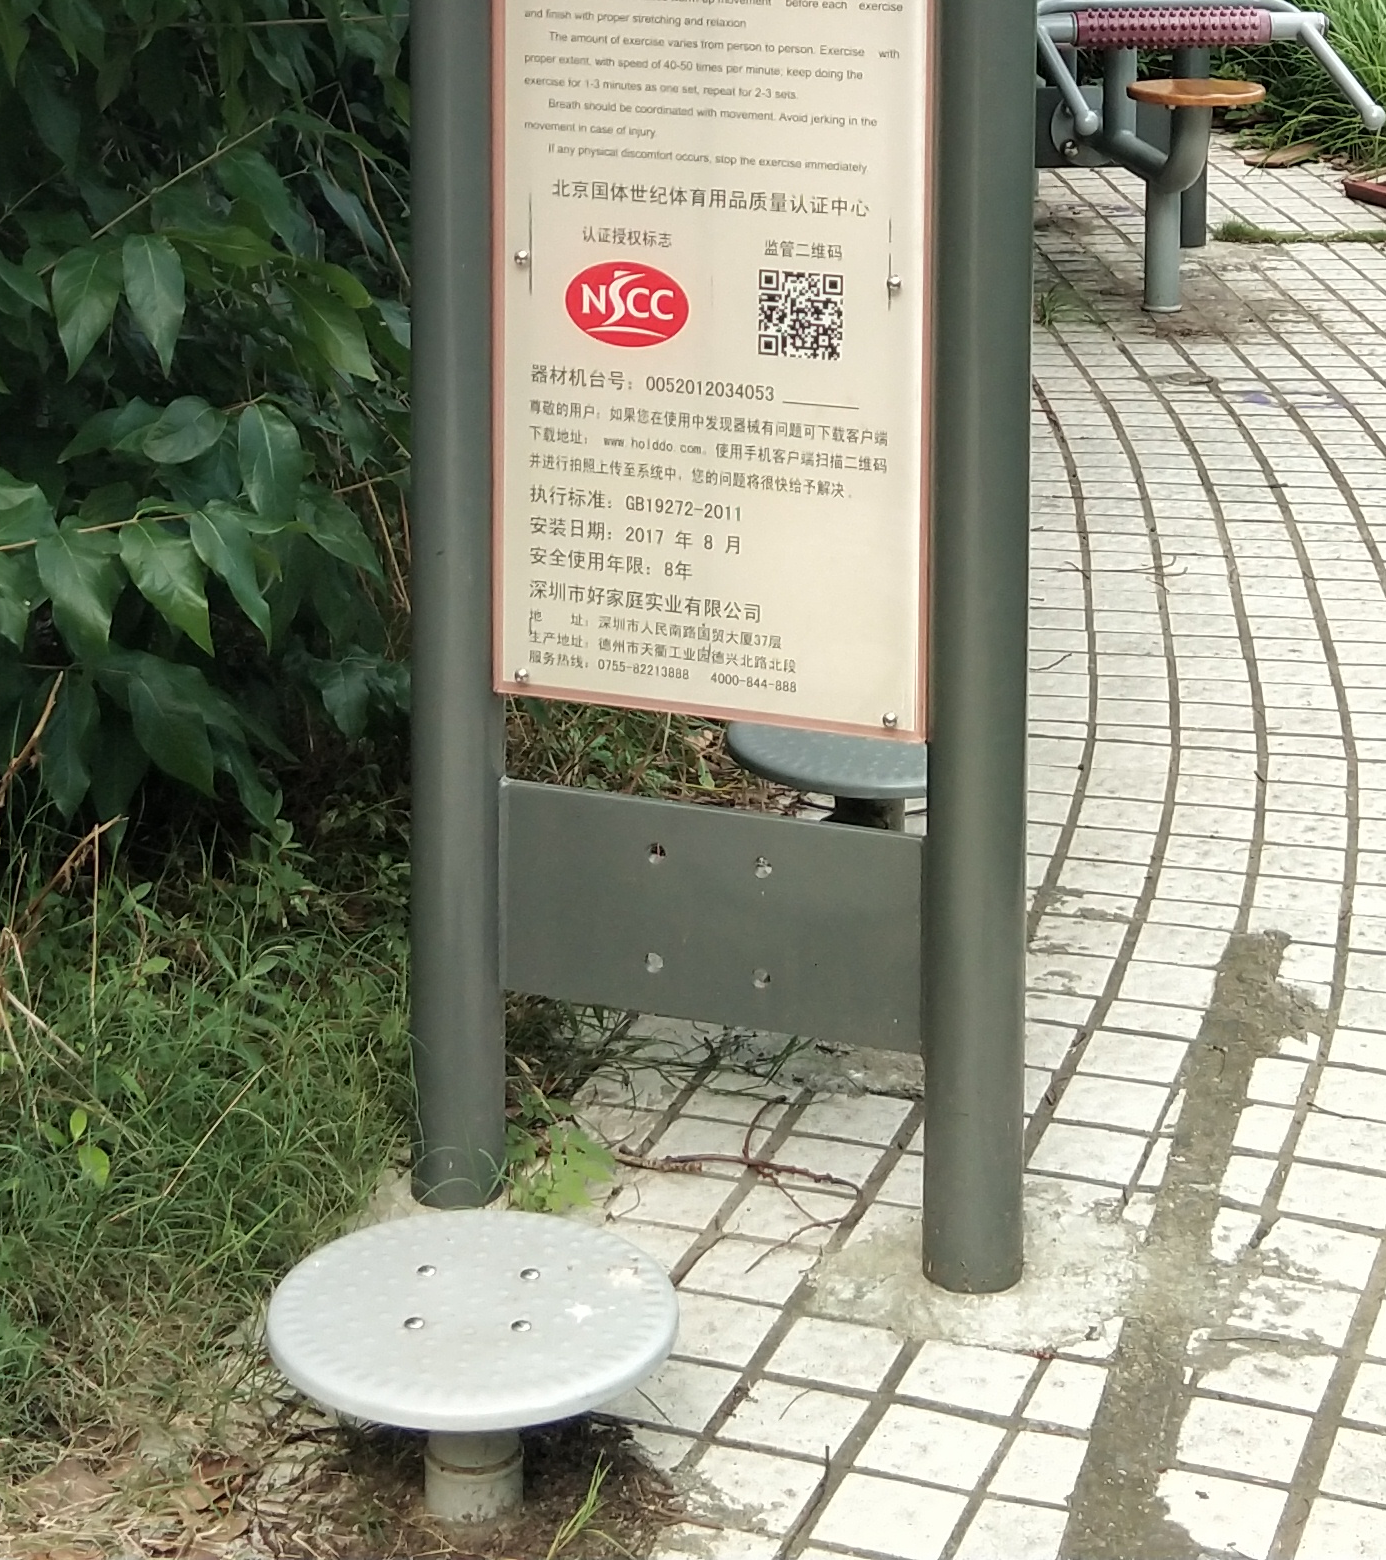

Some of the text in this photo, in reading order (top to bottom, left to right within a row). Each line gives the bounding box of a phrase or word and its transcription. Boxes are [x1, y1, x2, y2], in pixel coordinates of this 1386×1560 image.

[822, 0, 847, 9] each
[859, 2, 903, 11] exercise
[524, 10, 542, 18] and
[546, 9, 571, 19] finish
[575, 11, 594, 20] with
[597, 14, 628, 23] proper
[633, 15, 681, 27] stretching
[684, 16, 703, 26] and
[550, 31, 567, 42] The
[571, 34, 607, 44] amount
[611, 36, 620, 44] of
[623, 37, 664, 46] exercise
[668, 40, 698, 48] varies
[701, 41, 723, 50] from
[727, 42, 762, 51] person
[765, 43, 774, 52] to
[820, 45, 865, 57] Exercise
[879, 50, 899, 59] with
[524, 54, 556, 64] proper
[595, 58, 615, 67] with
[618, 59, 648, 69] speed
[651, 60, 660, 69] of
[663, 60, 693, 70] 40-50
[696, 63, 723, 72] times
[726, 65, 743, 74] per
[787, 68, 812, 78] keep
[815, 69, 843, 81] doing
[847, 70, 863, 80] the
[524, 77, 565, 86] exercise
[568, 79, 581, 87] for
[585, 79, 600, 88] 1-3
[603, 81, 642, 92] minutes
[645, 83, 657, 91] as
[660, 85, 678, 93] one
[703, 87, 735, 96] repeat
[739, 88, 751, 97] for
[755, 89, 771, 98] 2-3
[549, 99, 581, 109] Breath
[584, 101, 616, 112] should
[620, 103, 632, 113] be
[635, 104, 693, 116] coordinated
[697, 107, 717, 117] with
[779, 113, 807, 123] Avoid
[811, 115, 845, 127] jerking
[849, 117, 857, 125] in
[861, 117, 877, 126] the
[524, 122, 575, 132] movement
[579, 123, 587, 132] in
[590, 125, 614, 134] case
[617, 126, 626, 135] of
[557, 145, 575, 156] any
[578, 147, 617, 157] physical
[621, 148, 672, 160] discomfort
[715, 156, 737, 165] stop
[740, 156, 755, 165] the
[759, 158, 801, 168] exercise
[552, 178, 870, 217] 北京国体世纪体育用品质量认证中心
[582, 226, 672, 248] 认证授权标志
[764, 239, 843, 261] 监管二维码
[581, 270, 675, 326] NSCC
[529, 426, 588, 445] 下载地址：
[675, 531, 693, 550] 年
[704, 535, 713, 549] 8
[725, 536, 740, 554] 月
[530, 580, 761, 623] 深圳市好家庭实业有限公司
[710, 672, 797, 692] 4000-844-888
